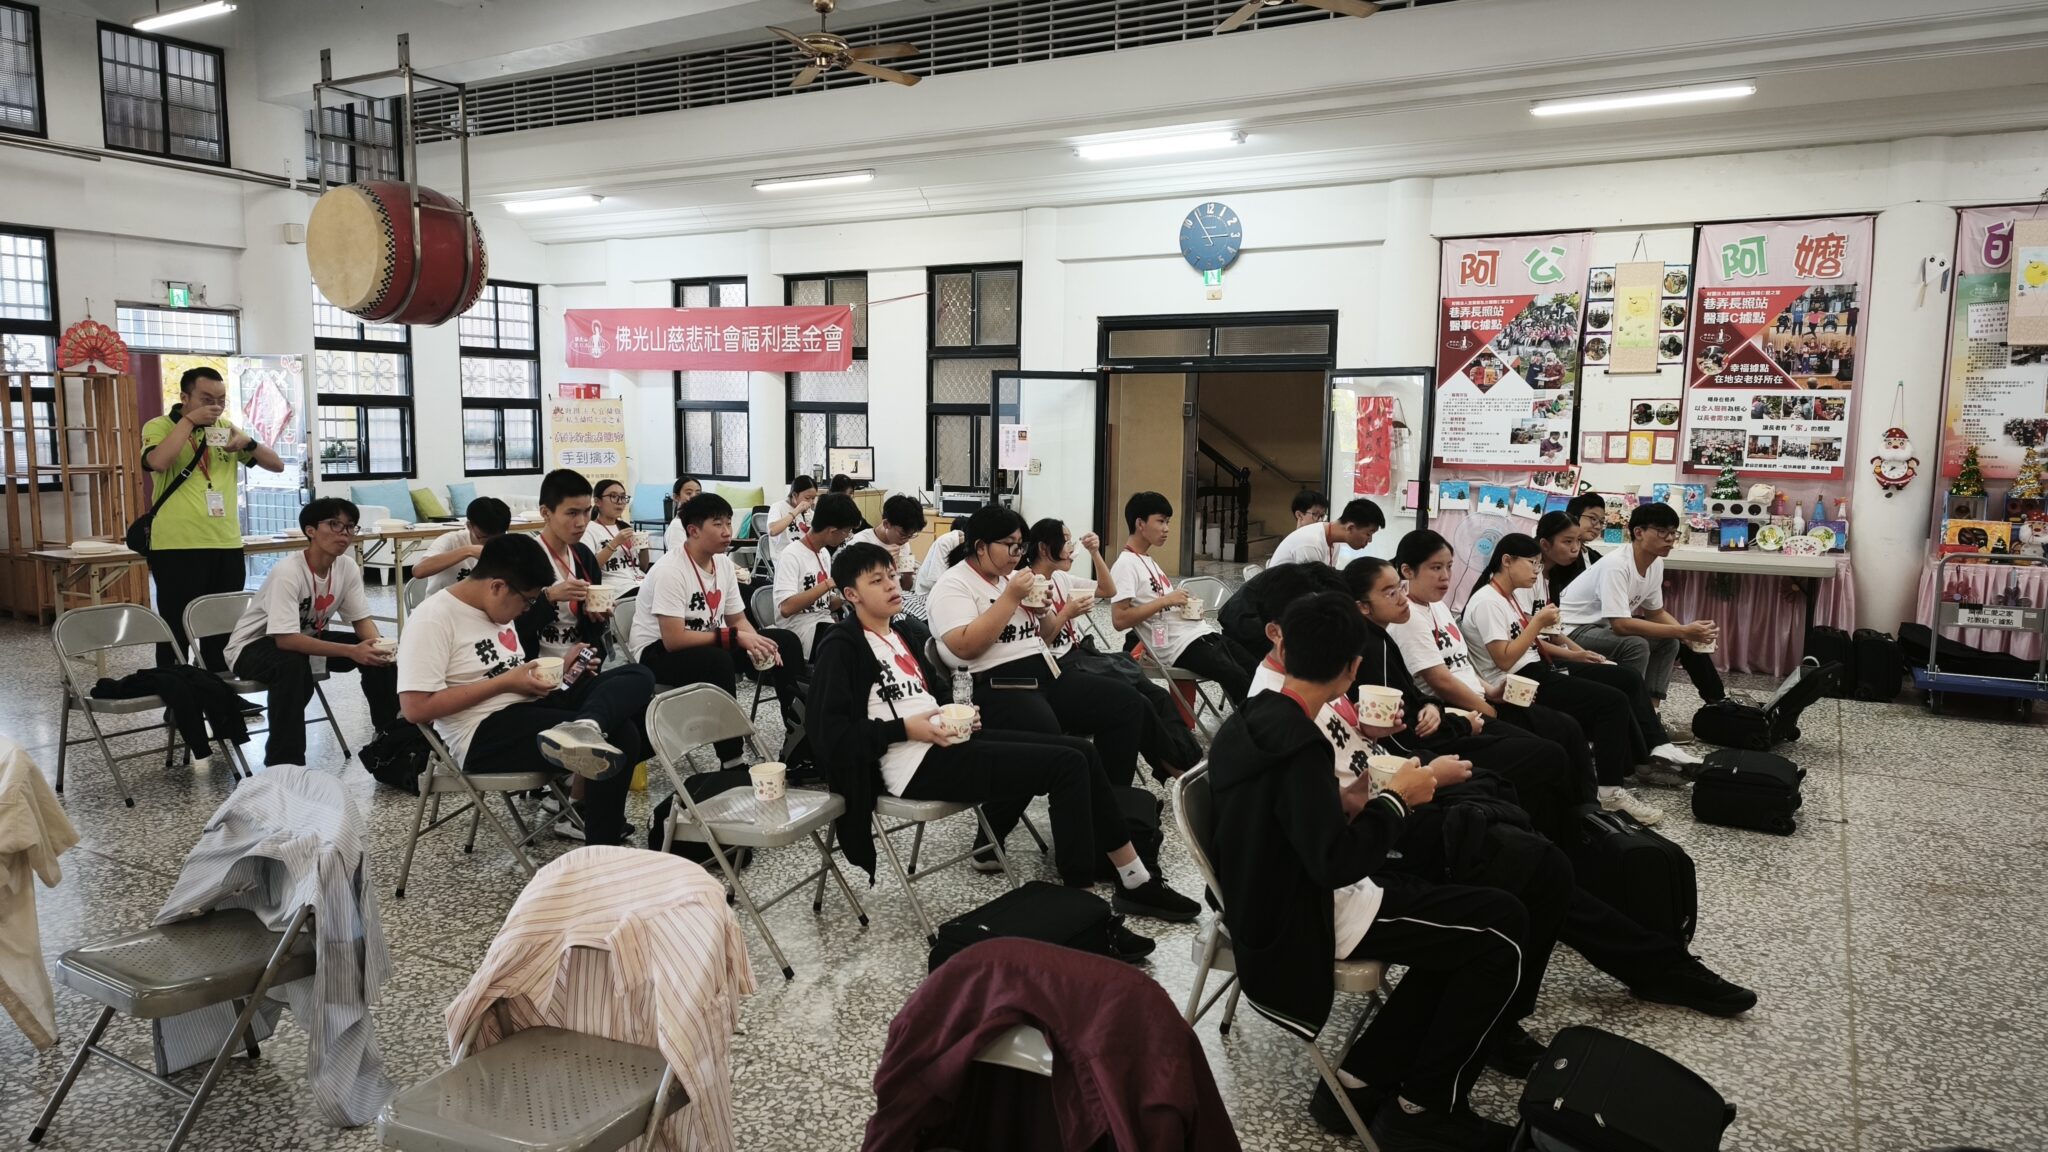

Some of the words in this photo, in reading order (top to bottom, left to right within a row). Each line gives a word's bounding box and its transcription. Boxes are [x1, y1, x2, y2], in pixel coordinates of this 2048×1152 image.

[1206, 203, 1215, 214] 12
[1226, 217, 1238, 226] 2
[1703, 297, 1769, 310] 巷弄長照站
[1448, 306, 1505, 319] 巷弄長照站
[1703, 311, 1767, 325] 醫事C據點
[1449, 319, 1503, 332] 醫事C據點
[616, 324, 844, 353] 佛光山慈悲社會福利基金會
[1730, 363, 1770, 373] 幸福據點
[1714, 374, 1784, 385] 在地安老好所在
[562, 451, 616, 464] 手到擒來
[474, 638, 500, 665] 我
[1326, 714, 1351, 750] 我
